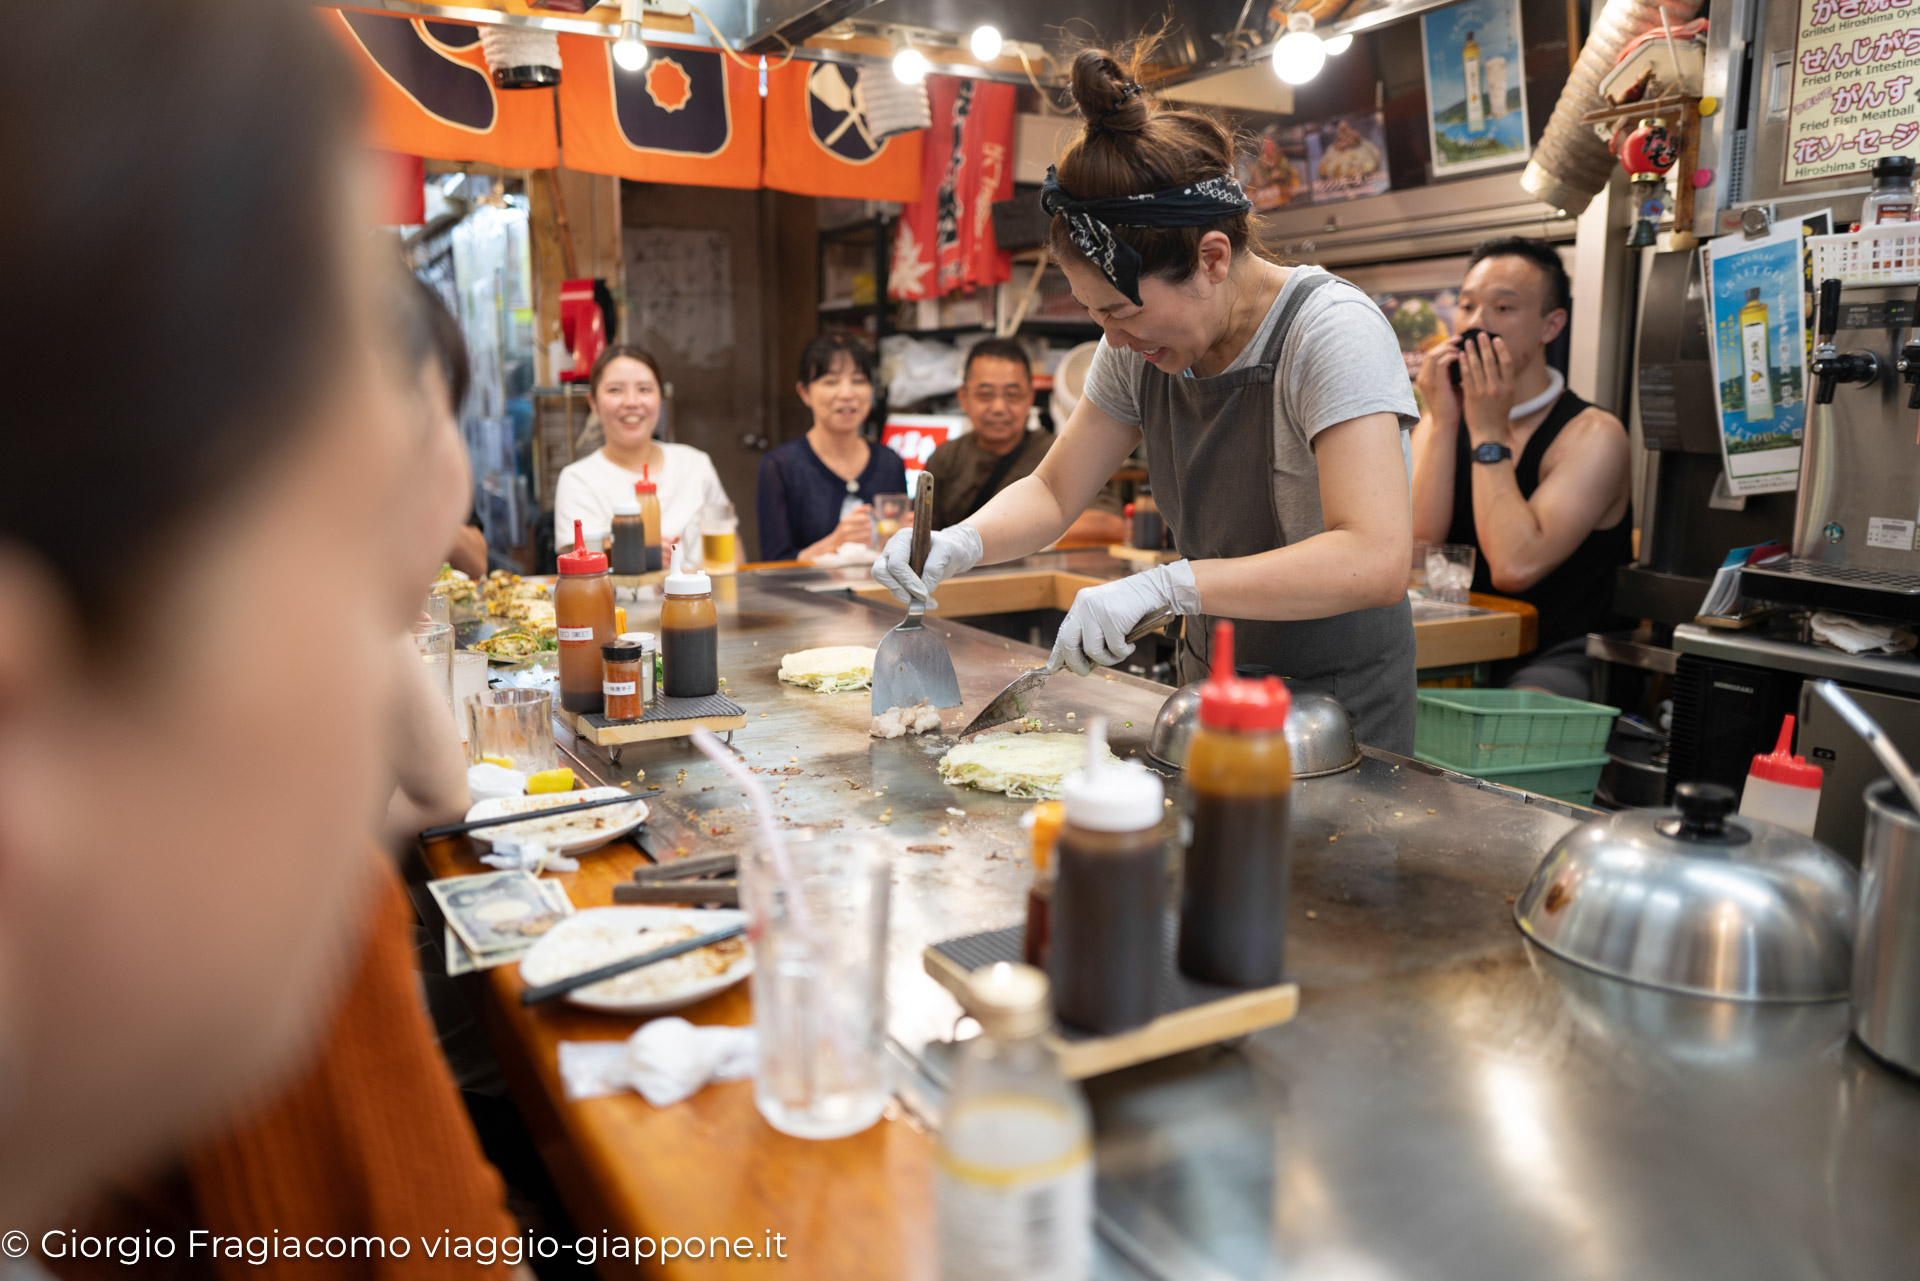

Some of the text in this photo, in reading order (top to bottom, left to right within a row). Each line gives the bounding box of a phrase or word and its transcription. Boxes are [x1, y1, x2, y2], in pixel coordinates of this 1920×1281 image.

[1801, 24, 1836, 39] Grilled
[1838, 13, 1894, 31] Hiroshima
[1810, 0, 1912, 26] かき
[1800, 28, 1920, 75] せんじがら
[1802, 73, 1831, 87] Fried
[1835, 67, 1862, 80] Pork
[1831, 75, 1912, 114] がんす
[1800, 104, 1914, 132] Fried Fish Meatball
[1794, 121, 1919, 165] 花ソーセージ
[1795, 162, 1856, 177] Hiroshima
[1720, 265, 1759, 298] CRAFT
